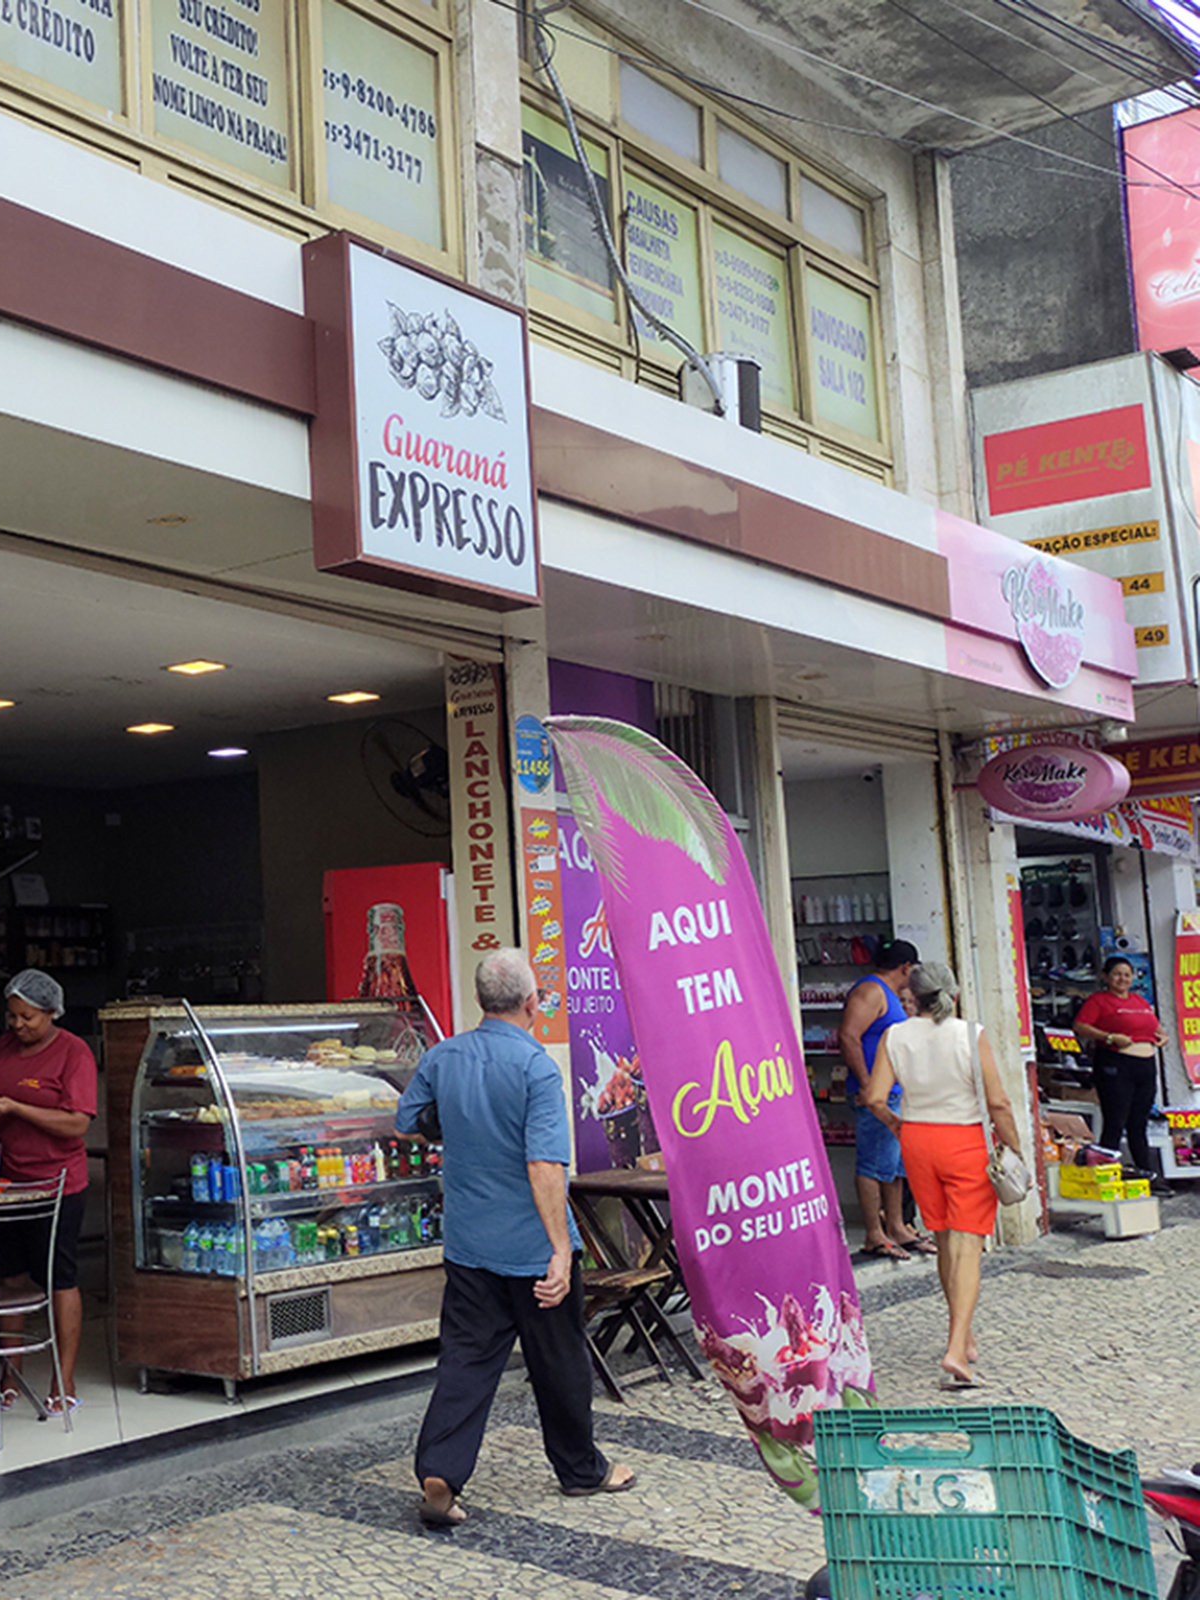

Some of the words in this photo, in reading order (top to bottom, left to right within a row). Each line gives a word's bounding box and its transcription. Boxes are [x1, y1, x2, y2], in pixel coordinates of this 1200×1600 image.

[169, 33, 208, 78] VOLTE
[210, 54, 220, 84] A
[221, 60, 244, 96] TER
[246, 72, 269, 107] SEU
[153, 73, 187, 116] NOME
[226, 108, 245, 143] NA
[626, 190, 679, 237] CAUSAS
[382, 413, 508, 491] Guaraná
[997, 453, 1029, 482] PÉ
[368, 460, 526, 567] EXPRESSO
[1129, 578, 1151, 592] 44
[1143, 630, 1165, 643] 49
[649, 899, 732, 951] AQUI
[677, 968, 743, 1015] TEM
[672, 1040, 794, 1138] Açaí
[706, 1158, 815, 1216] MONTE
[695, 1223, 732, 1252] DO
[740, 1211, 784, 1243] SEU
[789, 1195, 829, 1231] JEITO
